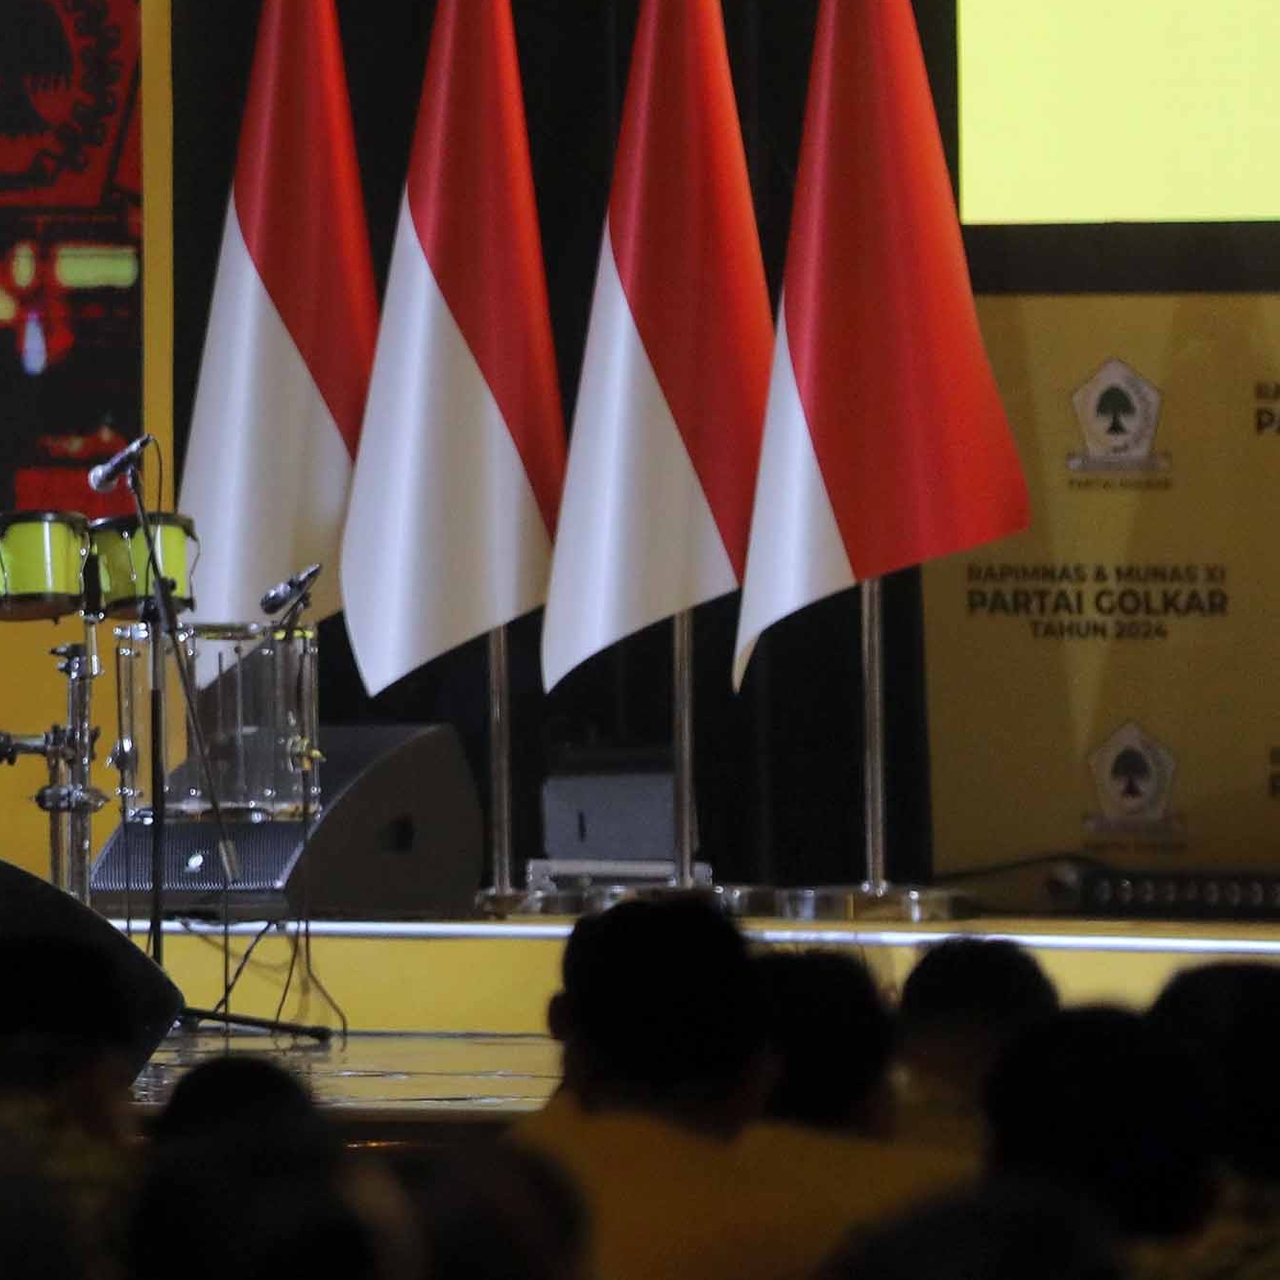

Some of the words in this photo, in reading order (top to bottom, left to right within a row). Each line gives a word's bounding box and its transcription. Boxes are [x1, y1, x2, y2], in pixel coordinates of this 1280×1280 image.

[967, 589, 1084, 617] PARTAI
[1094, 588, 1228, 617] GOLKAR
[1030, 621, 1108, 640] TAHUN
